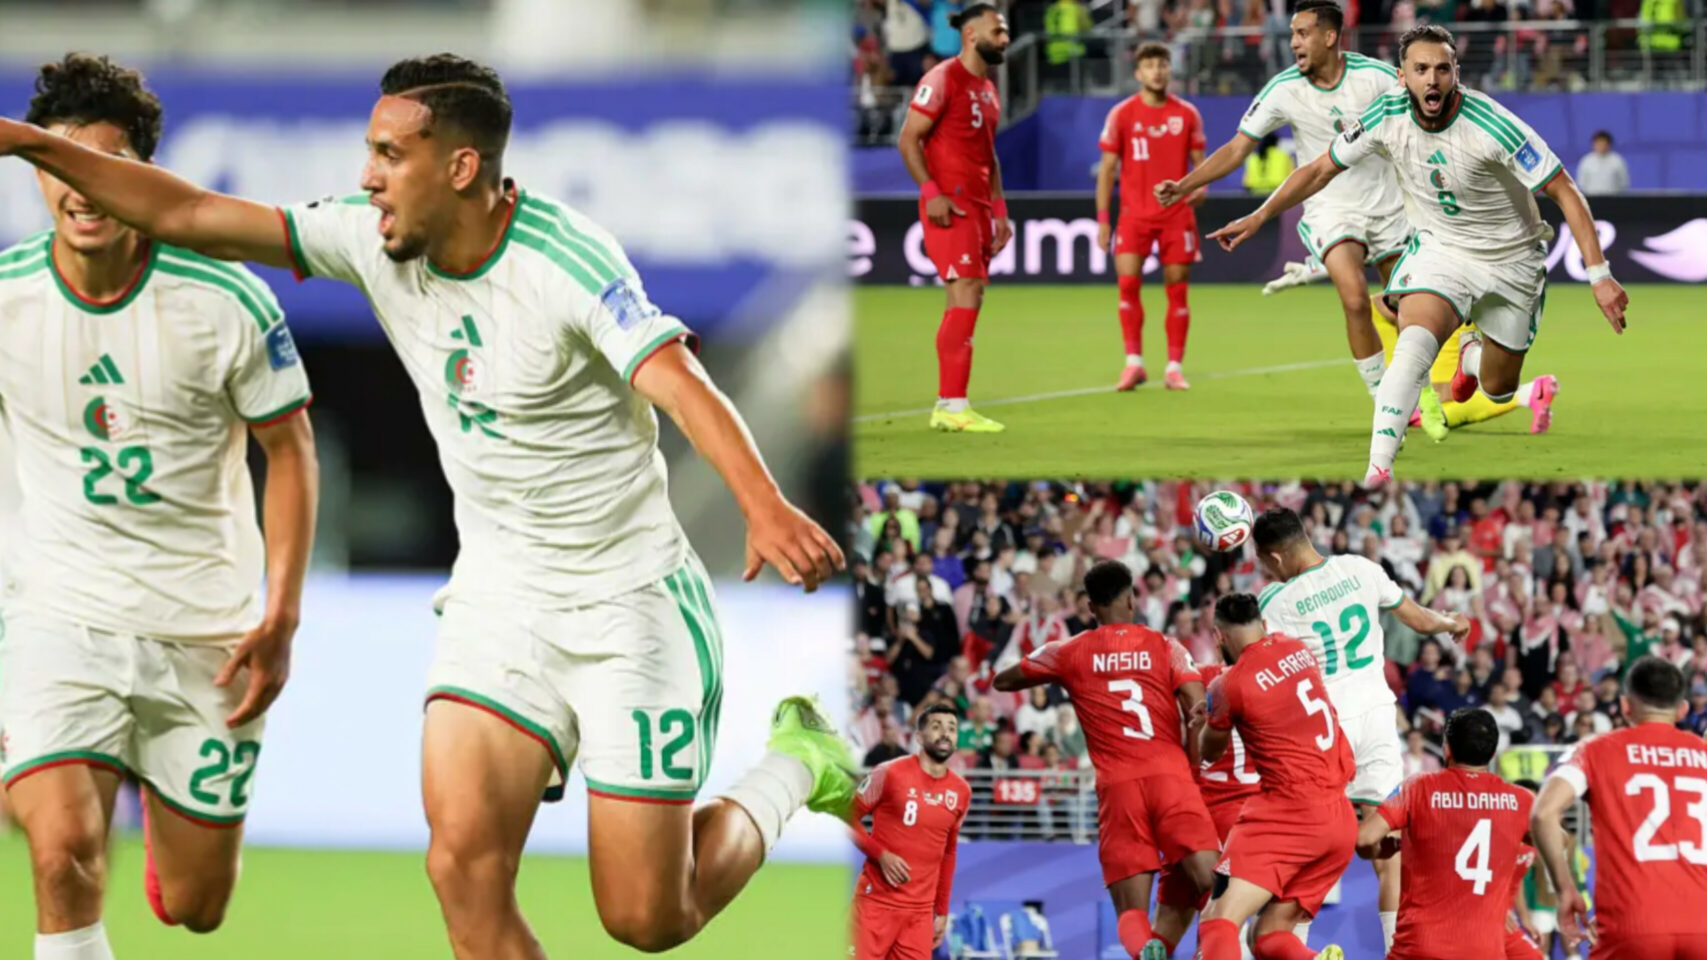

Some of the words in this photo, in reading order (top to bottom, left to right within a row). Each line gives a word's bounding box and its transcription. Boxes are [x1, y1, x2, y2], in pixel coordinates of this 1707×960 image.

[971, 102, 983, 128] 5
[1131, 136, 1150, 161] 11
[79, 445, 162, 506] 22
[1295, 575, 1362, 616] BENBOUALI
[1093, 651, 1152, 673] NASIB
[1311, 603, 1375, 676] 12
[1108, 679, 1155, 740] 3
[1296, 679, 1335, 752] 5
[189, 738, 262, 808] 22
[632, 708, 695, 780] 12
[1625, 743, 1707, 770] EHSAN
[903, 800, 918, 827] 8
[1431, 791, 1464, 809] ABU
[1467, 792, 1518, 812] DAHAB
[1624, 772, 1707, 866] 23
[1454, 818, 1493, 895] 4
